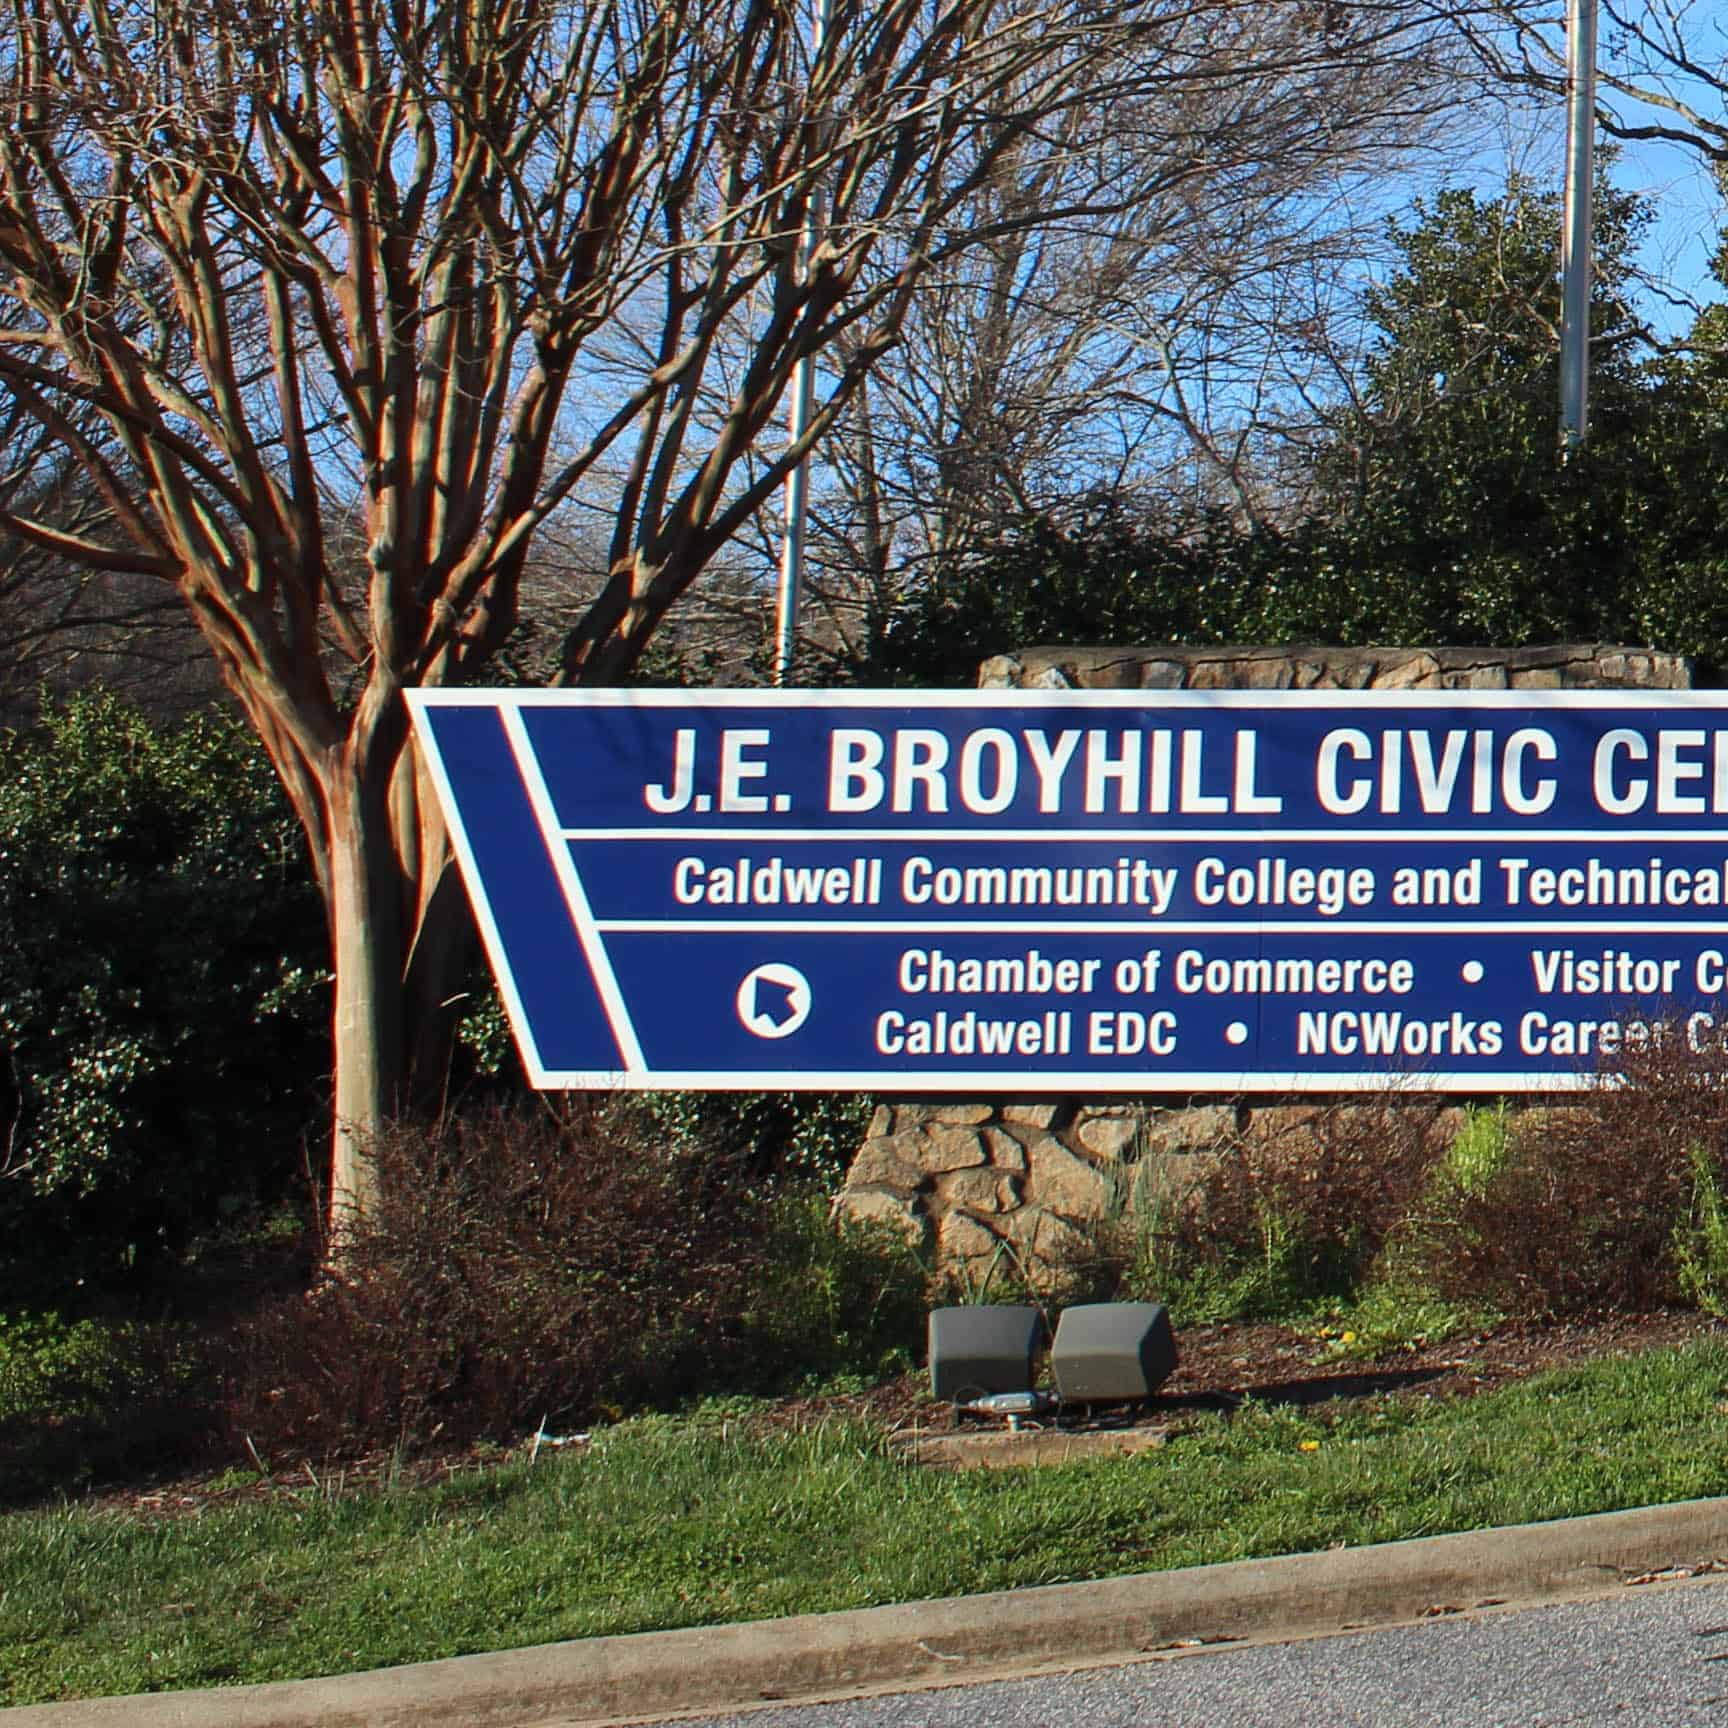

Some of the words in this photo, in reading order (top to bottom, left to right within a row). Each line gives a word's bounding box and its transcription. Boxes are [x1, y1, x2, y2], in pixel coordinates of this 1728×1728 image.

[643, 728, 791, 814] J.E.
[827, 728, 1282, 815] BROYHILL
[1315, 728, 1557, 815] CIVIC
[672, 857, 882, 905] Caldwell
[901, 857, 1178, 916] Community
[1193, 857, 1375, 916] College
[1391, 858, 1481, 906] and
[897, 949, 1101, 995] Chamber
[1113, 949, 1161, 995] of
[1173, 949, 1414, 995] Commerce
[1531, 950, 1681, 995] Visitor
[874, 1010, 1071, 1056] Caldwell
[1087, 1010, 1177, 1056] EDC
[1296, 1011, 1503, 1056] NCWorks
